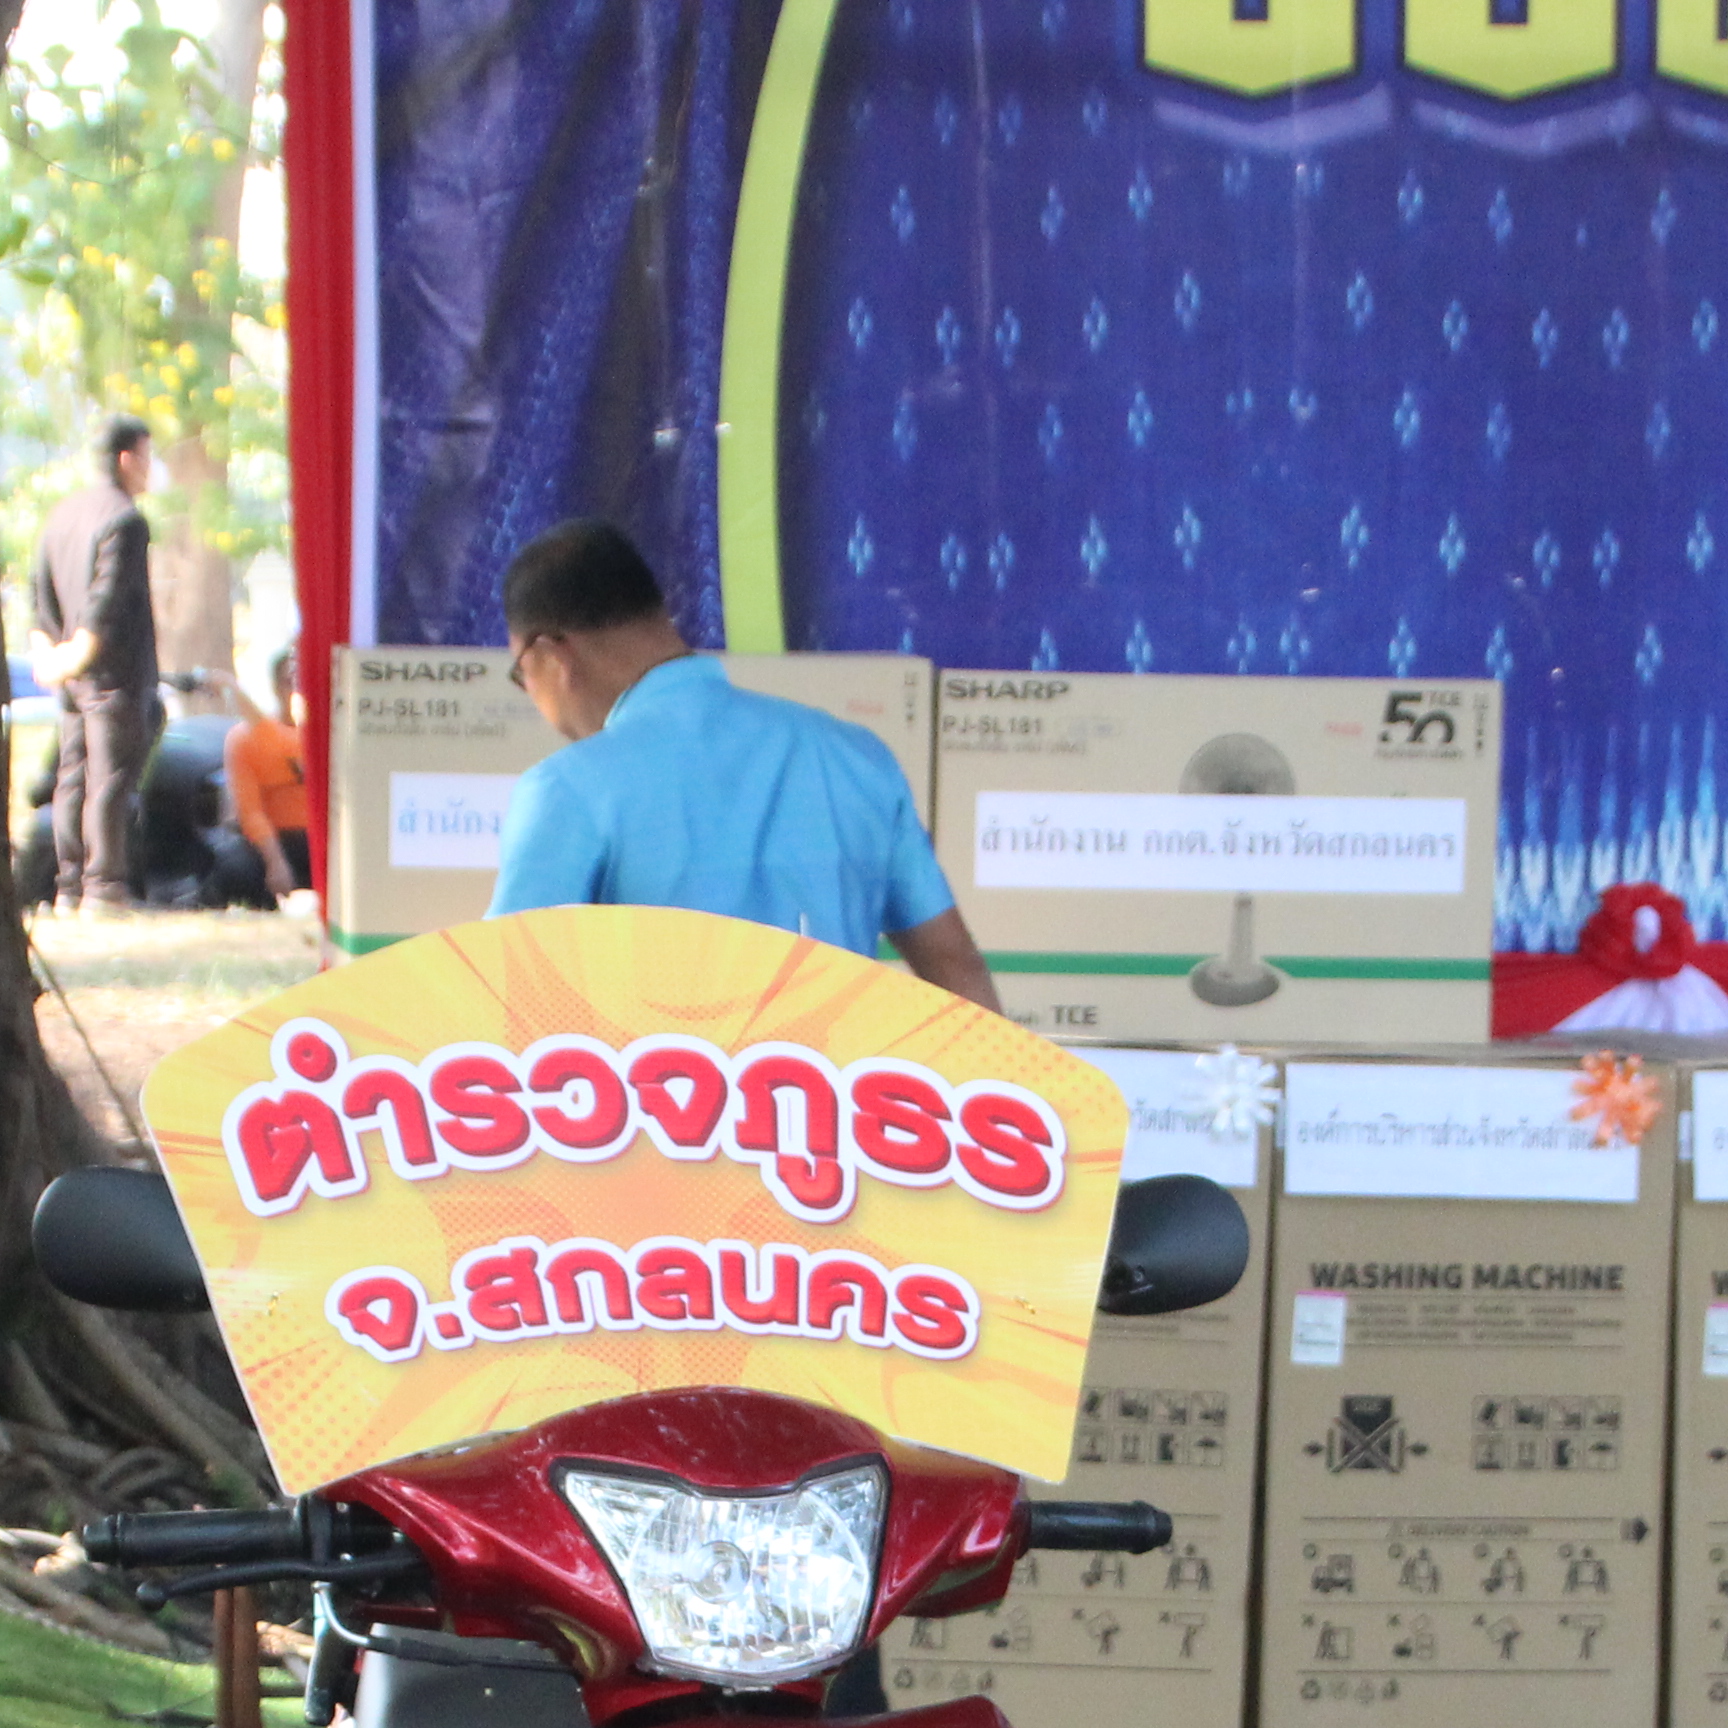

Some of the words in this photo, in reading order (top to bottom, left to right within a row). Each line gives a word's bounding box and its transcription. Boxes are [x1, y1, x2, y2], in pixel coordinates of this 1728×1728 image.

[359, 660, 487, 681] SHARP
[945, 679, 1070, 699] SHARP
[358, 698, 459, 716] PJ-SL181
[942, 714, 1044, 734] PJ-SL181
[980, 814, 1128, 853] สำนักงาน
[1052, 1004, 1098, 1025] TCE
[235, 1029, 1065, 1212] ตำรวจภูธร
[1310, 1263, 1462, 1289] WASHING
[1474, 1264, 1624, 1290] MACHINE
[337, 1241, 974, 1354] จ.สกลนคร
